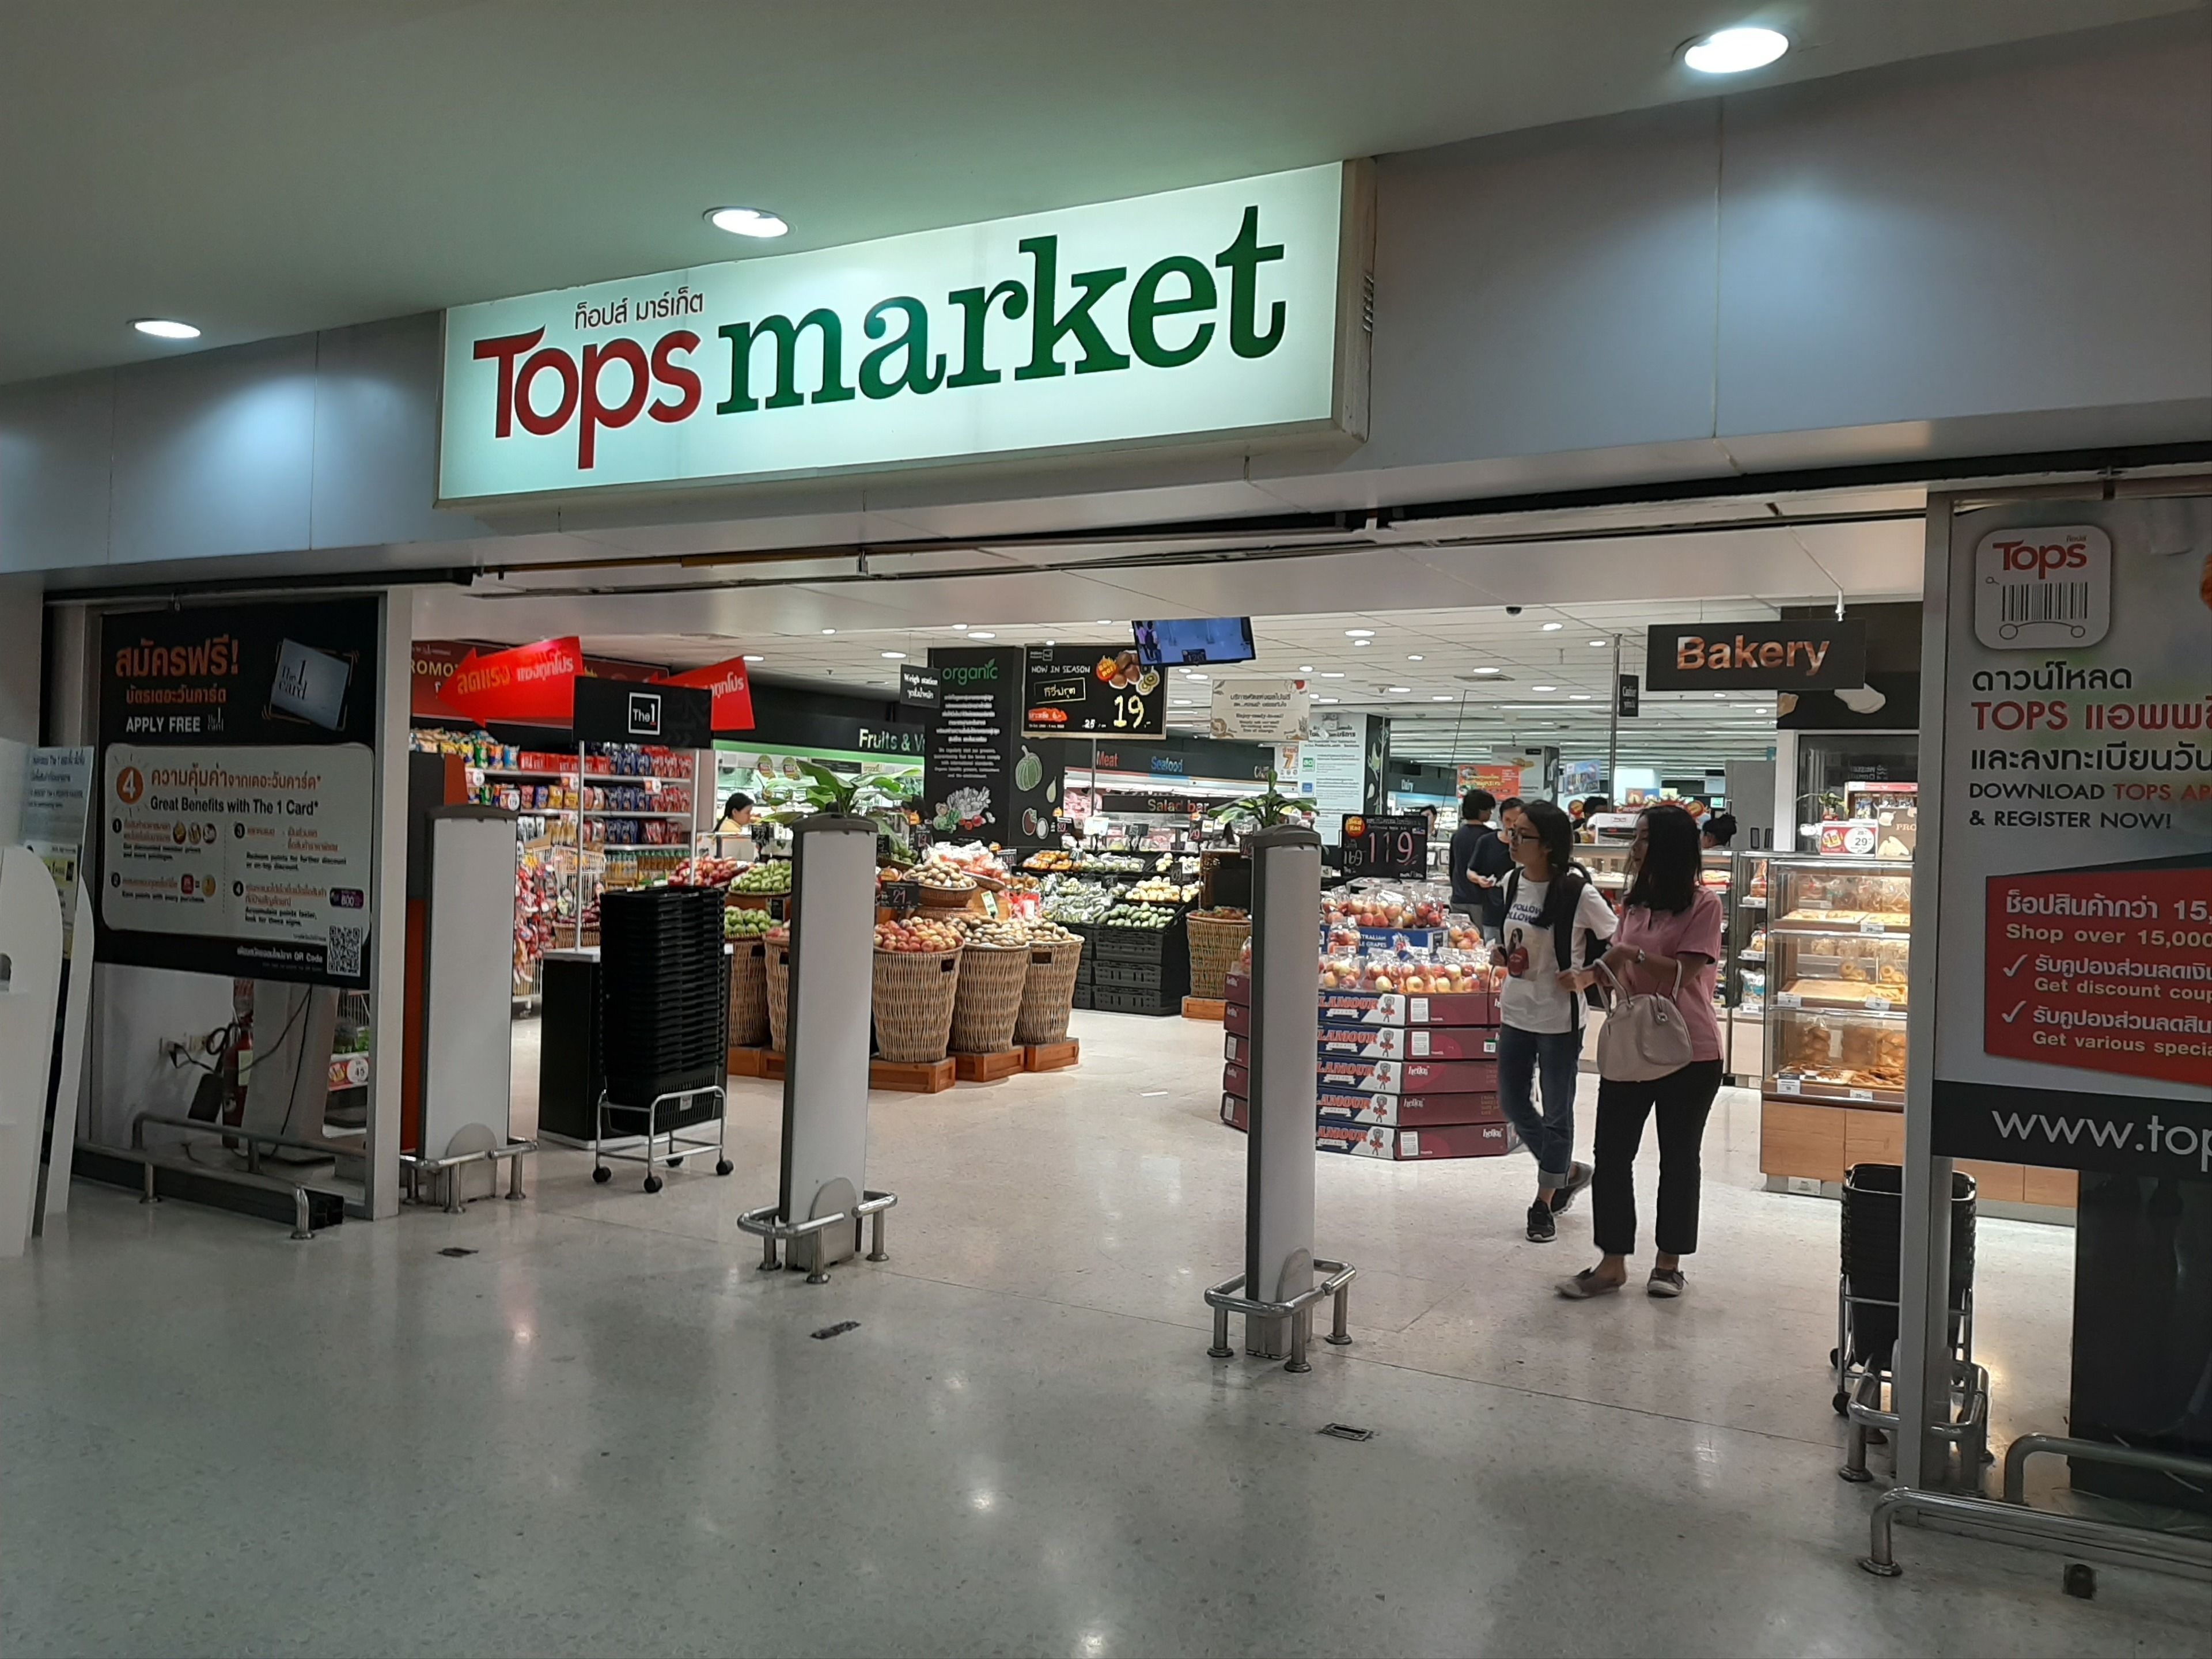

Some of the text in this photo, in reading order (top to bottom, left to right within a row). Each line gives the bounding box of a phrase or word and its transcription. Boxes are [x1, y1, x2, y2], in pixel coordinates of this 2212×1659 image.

[575, 286, 703, 330] ท็อปส์ มาร์เก็ต
[473, 206, 1285, 469] Tops market
[1993, 540, 2087, 579] Tops
[115, 634, 240, 678] สมัครฟรี!
[1677, 635, 1830, 676] Bakery
[411, 660, 459, 677] ROMO
[457, 665, 511, 695] ลดแรง
[942, 662, 998, 685] organic
[1031, 665, 1090, 674] NOW IN SEASON
[1972, 661, 2132, 691] ดาวน์โหลด
[126, 716, 164, 733] APPLY
[169, 716, 201, 733] FREE
[1971, 700, 2069, 730] TOPS
[859, 728, 897, 751] Fruits
[901, 733, 912, 751] &
[1096, 751, 1184, 773] Meat Seafood
[1971, 741, 2212, 771] และลงทะเบียนวัน
[123, 768, 136, 800] 4
[1969, 783, 2104, 800] DOWNLOAD
[2113, 783, 2171, 801] TOPS
[150, 796, 179, 811] Great
[181, 797, 224, 813] Benefits
[228, 798, 249, 813] with
[253, 799, 273, 814] The
[276, 800, 282, 814] 1
[1147, 799, 1210, 813] Salad bar
[1969, 810, 2171, 829] & REGISTER NOW!
[2005, 923, 2212, 948] Shop over 15,000
[2034, 977, 2069, 993] Get
[2076, 980, 2161, 998] discount
[2032, 1030, 2067, 1047] Get
[2074, 1035, 2146, 1053] various
[1317, 1094, 1372, 1110] AMOUR
